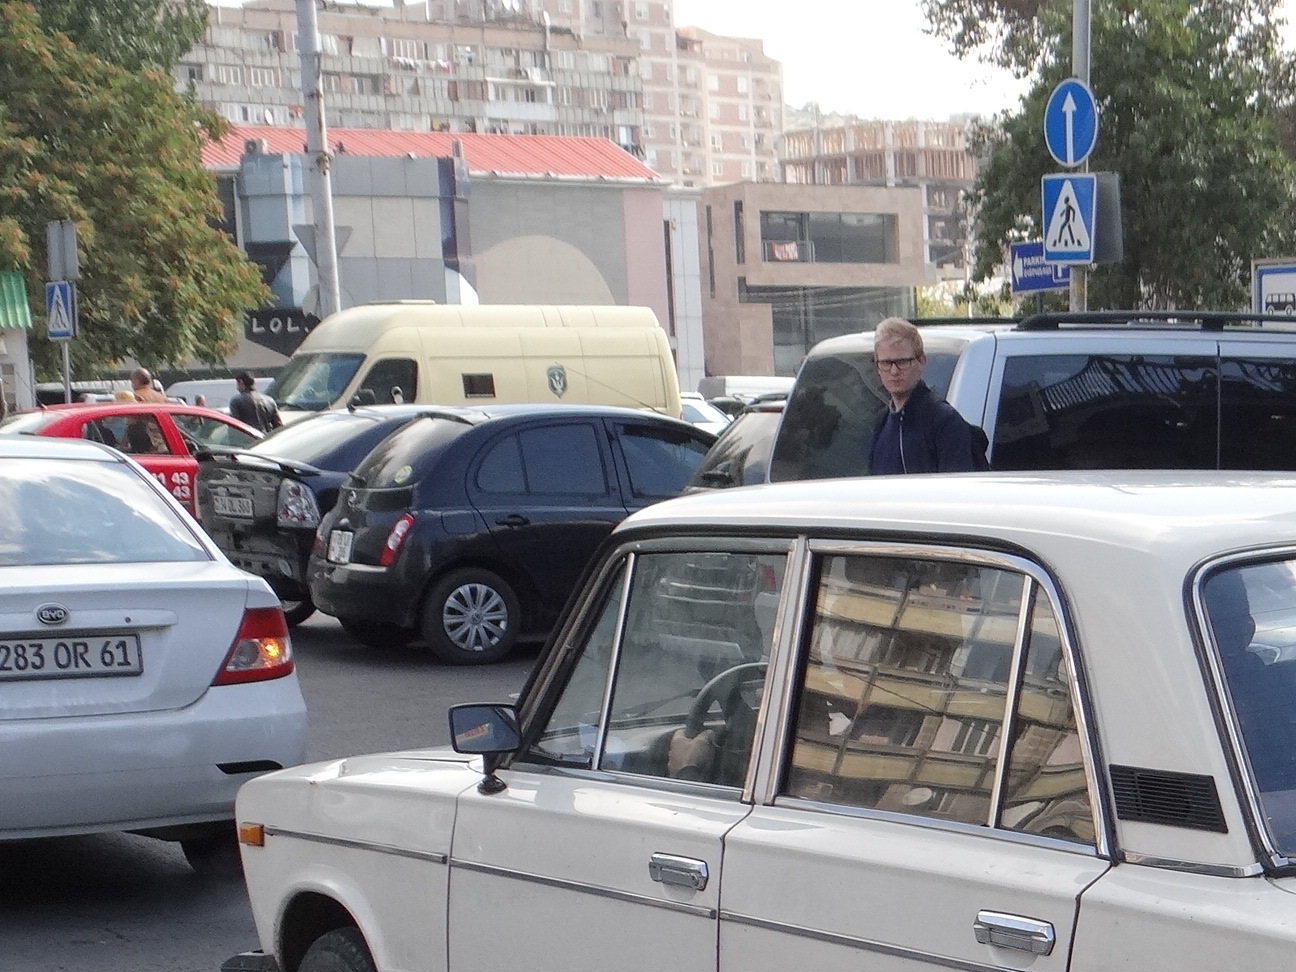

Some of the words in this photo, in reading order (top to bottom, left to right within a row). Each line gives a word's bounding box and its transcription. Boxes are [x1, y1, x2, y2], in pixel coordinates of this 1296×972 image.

[1023, 255, 1046, 267] PARKI
[0, 642, 45, 671] 283
[54, 641, 92, 669] OR
[100, 640, 132, 667] 61
